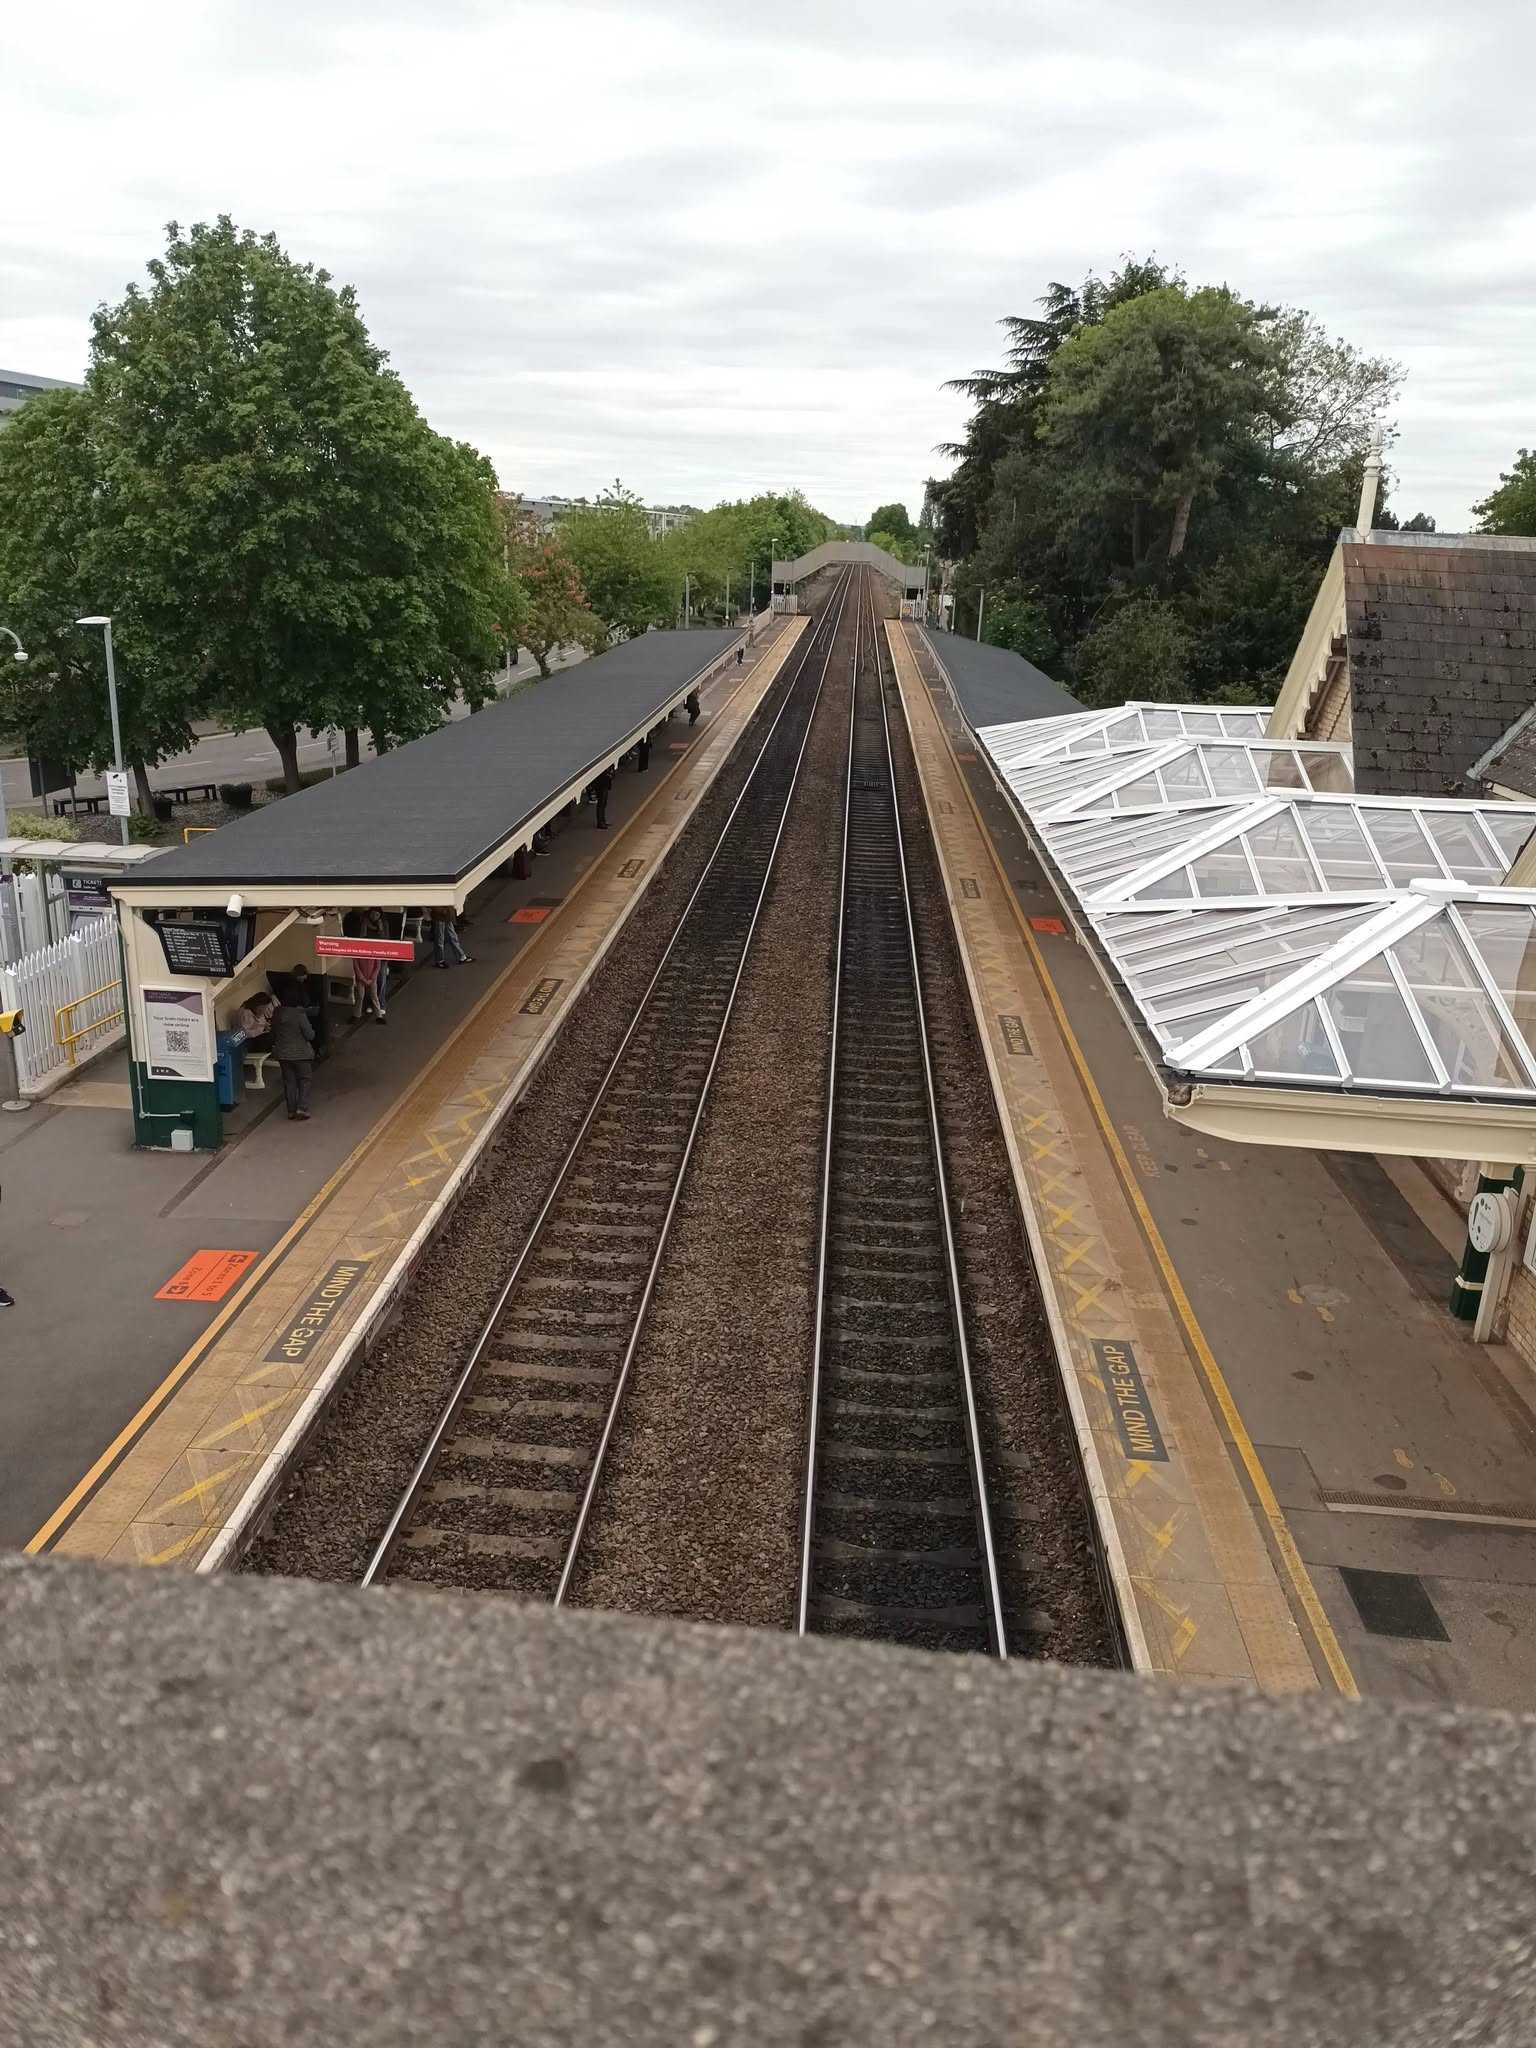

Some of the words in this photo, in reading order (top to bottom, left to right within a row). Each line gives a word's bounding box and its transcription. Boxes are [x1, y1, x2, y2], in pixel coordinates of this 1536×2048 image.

[1136, 1154, 1160, 1178] KEEP
[320, 1266, 359, 1298] MIND
[300, 1300, 336, 1326] THE
[281, 1327, 315, 1357] GAP
[1104, 1345, 1130, 1376] GAP
[1112, 1378, 1141, 1406] THE
[1122, 1409, 1156, 1454] MIND
